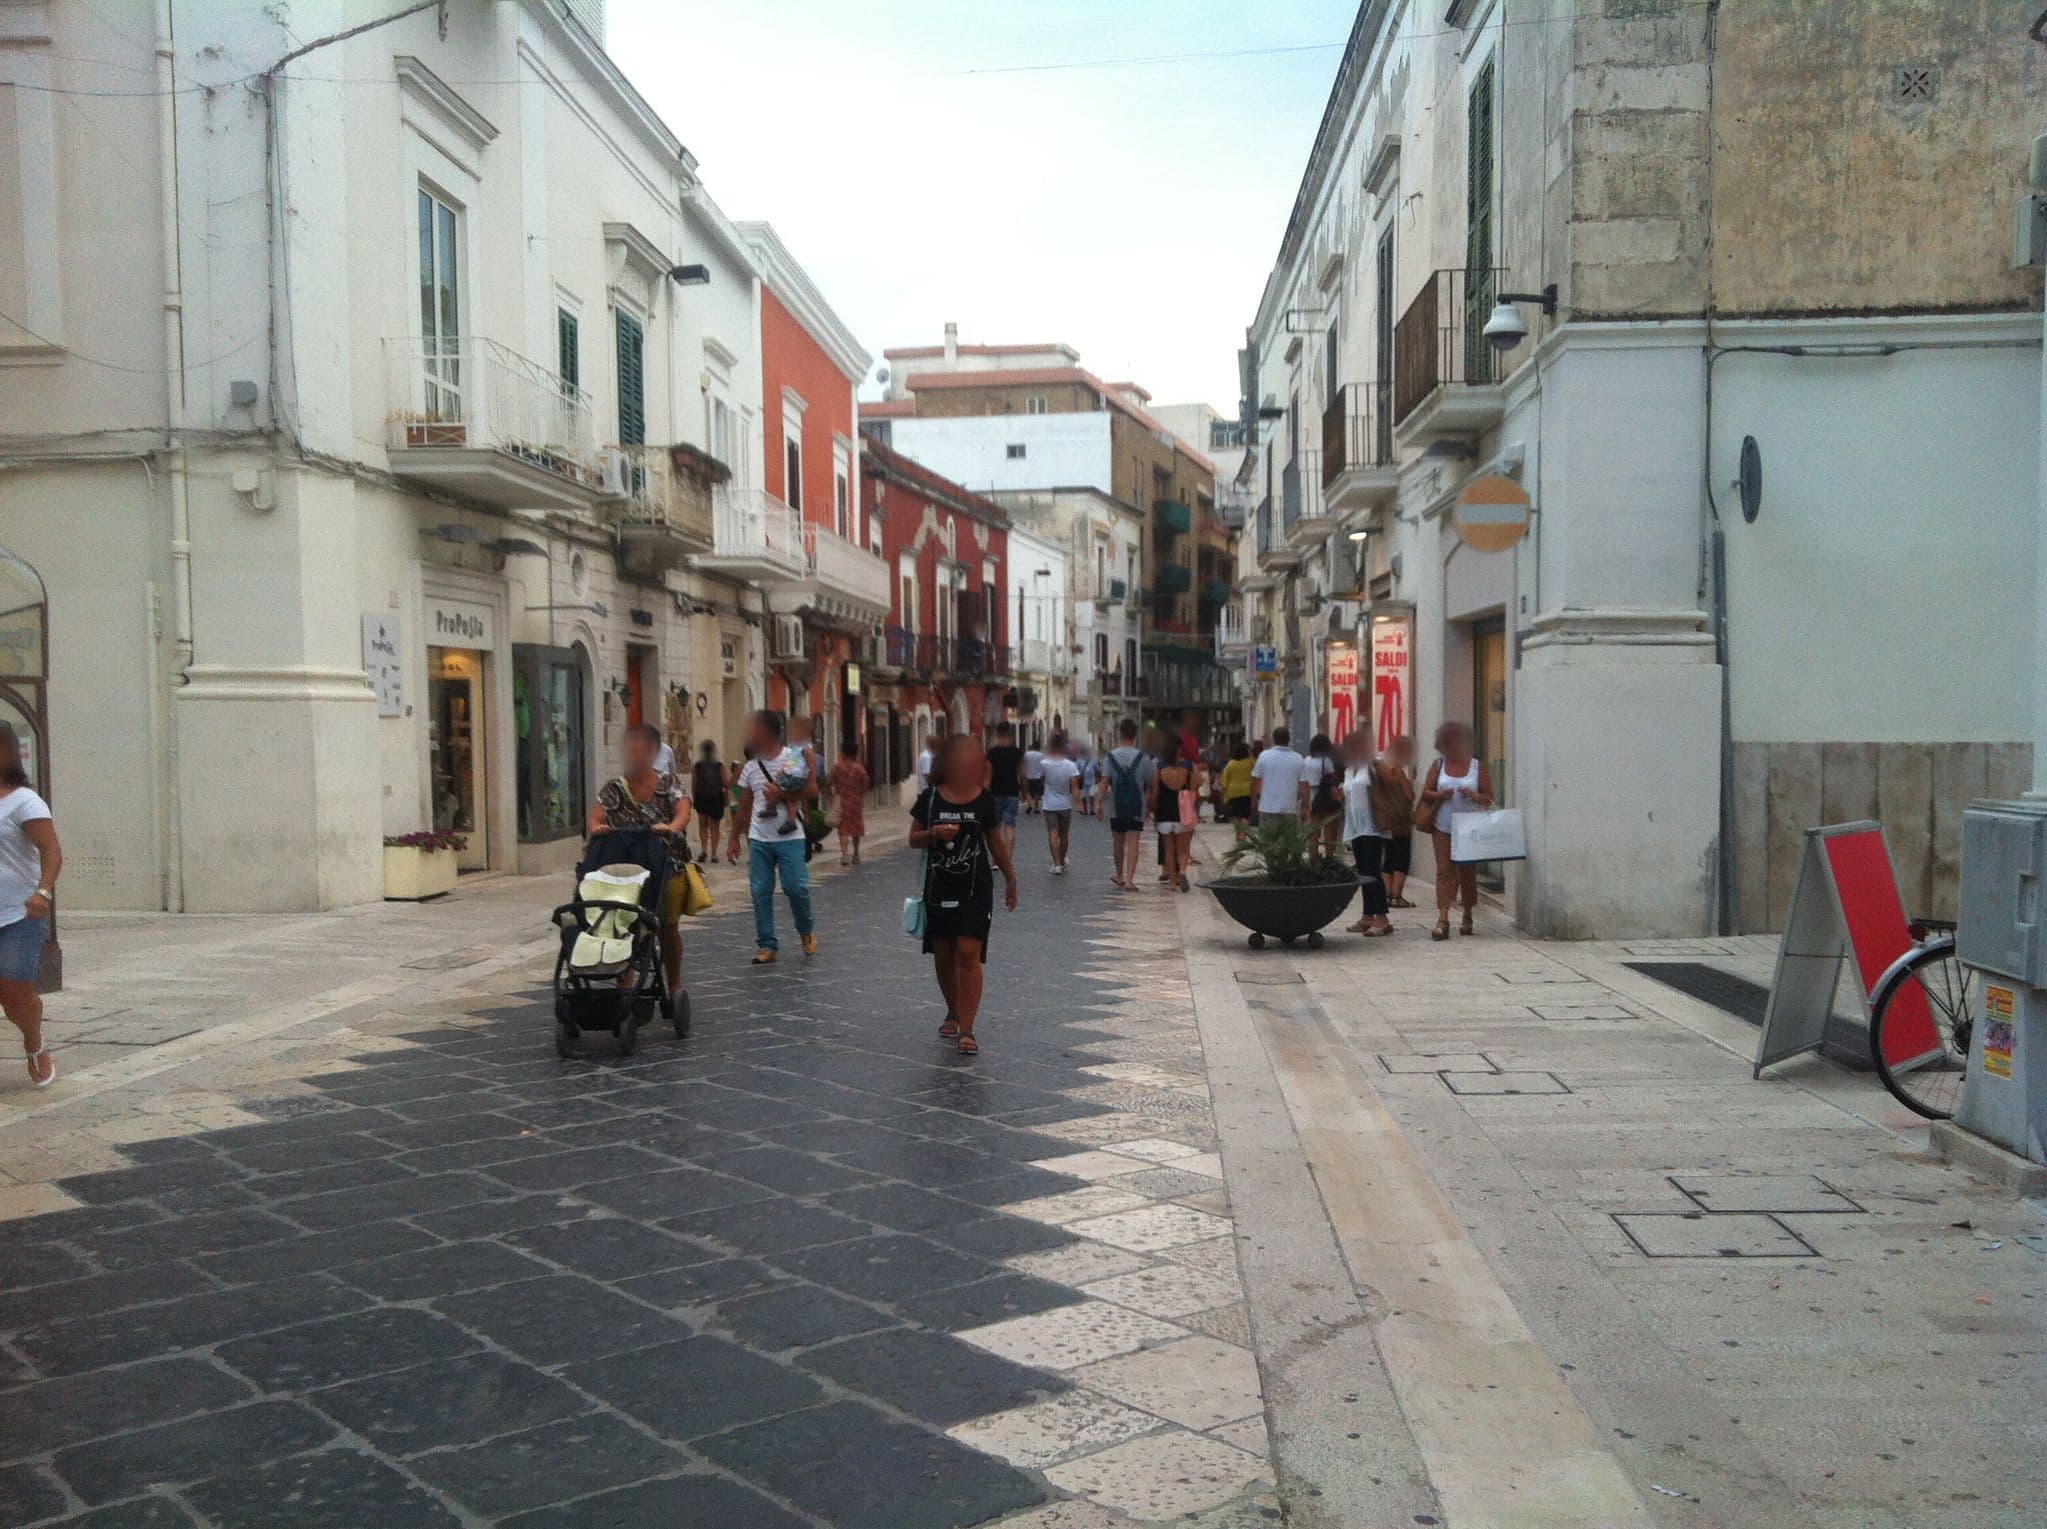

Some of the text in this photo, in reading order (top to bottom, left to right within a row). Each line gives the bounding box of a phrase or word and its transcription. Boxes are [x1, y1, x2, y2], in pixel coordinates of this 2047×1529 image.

[1375, 652, 1408, 667] SALDI
[1331, 673, 1359, 687] SALDI
[1376, 675, 1402, 752] 70
